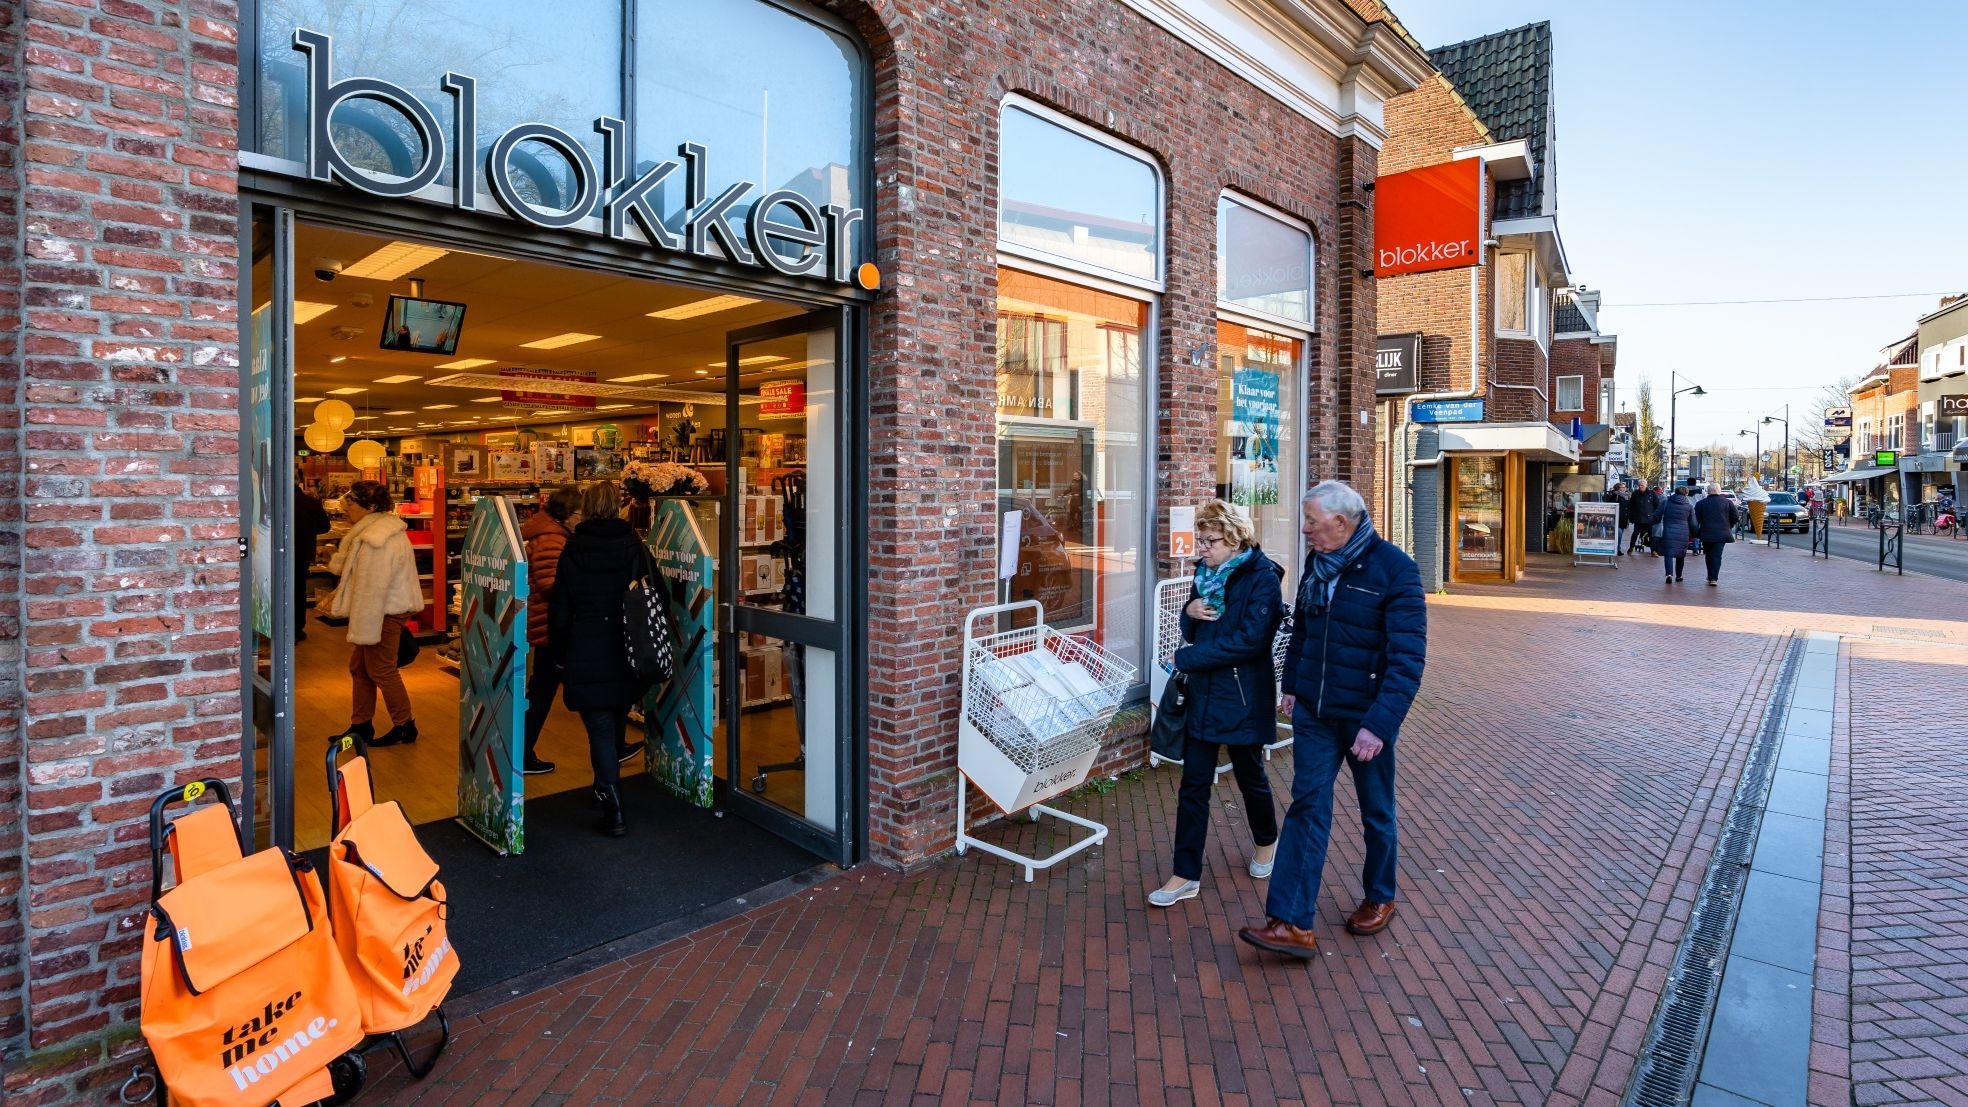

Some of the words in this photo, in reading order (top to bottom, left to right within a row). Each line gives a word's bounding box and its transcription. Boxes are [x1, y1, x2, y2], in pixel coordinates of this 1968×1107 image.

[775, 387, 793, 395] SALE
[1238, 384, 1259, 397] Klaar
[1260, 389, 1276, 399] voor
[1236, 396, 1248, 408] het
[1248, 399, 1277, 411] voorjaar
[1429, 408, 1463, 417] Veenpad
[464, 549, 487, 567] Klaar
[487, 555, 508, 571] voor
[675, 550, 697, 564] voor
[463, 567, 474, 584] het
[474, 573, 511, 592] voorjaar
[661, 565, 700, 583] voorjaar
[221, 990, 302, 1046] take
[219, 1027, 278, 1070] me
[228, 1016, 338, 1092] home.
